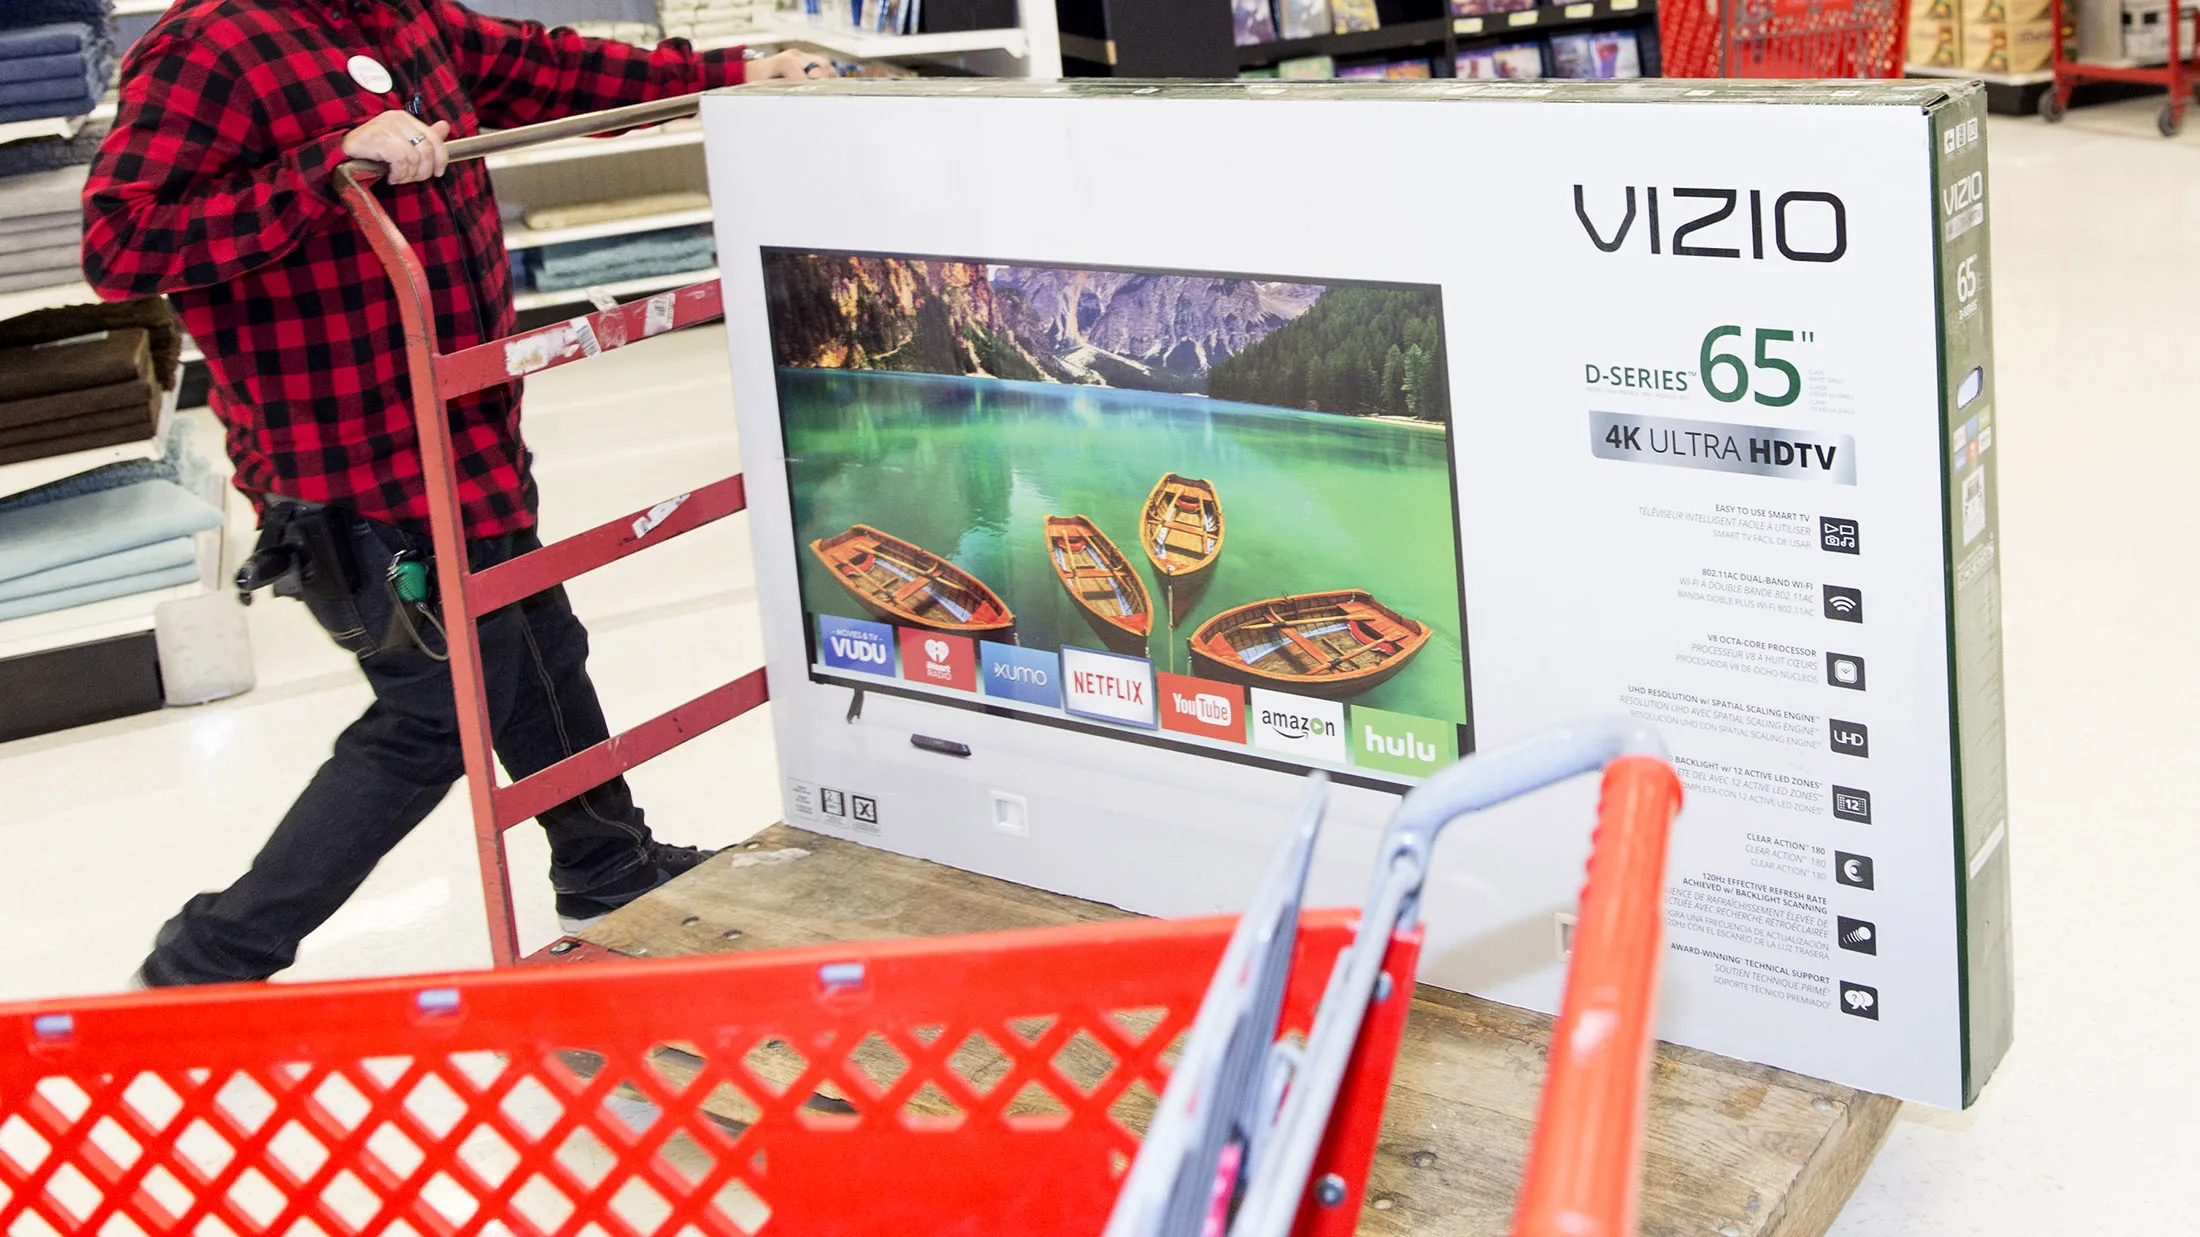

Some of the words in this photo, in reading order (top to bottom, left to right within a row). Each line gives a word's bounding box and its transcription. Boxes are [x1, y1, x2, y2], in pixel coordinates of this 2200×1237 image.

[1943, 170, 1983, 215] VIZIO
[1573, 184, 1847, 263] VIZIO
[1700, 324, 1814, 407] 65"
[1605, 424, 1642, 451] 4K
[1650, 428, 1741, 463] ULTRA
[1750, 438, 1837, 470] HDTV
[1716, 505, 1735, 513] EASY
[1738, 507, 1748, 515] TO
[1751, 509, 1766, 517] USE
[1768, 511, 1797, 520] SMART
[1713, 530, 1739, 540] SMART
[1742, 533, 1753, 542] TV
[1777, 537, 1787, 546] DE
[1789, 539, 1811, 549] USAR
[1738, 519, 1764, 530] FACILE
[1775, 524, 1811, 535] UTILISER
[1702, 569, 1737, 580] 802.11AC
[1741, 574, 1789, 586] DUAL-BAND
[1792, 581, 1812, 589] WI-FI
[1708, 581, 1742, 593] DOUBLE
[1744, 586, 1772, 597] BANDE
[1775, 590, 1813, 603] 802.11AC
[830, 636, 886, 664] VUDU
[1691, 643, 1743, 659] PROCESSEUR
[1745, 652, 1755, 660] V8
[1708, 634, 1717, 642] V8
[1720, 636, 1765, 649] OCTA-CORE
[1768, 643, 1816, 657] PROCESSOR
[1074, 670, 1143, 705] NETFLIX
[1172, 692, 1229, 722] YouTube
[1628, 685, 1645, 694] UHD
[1648, 688, 1697, 703] RESOLUTION
[1712, 699, 1744, 711] SPATIAL
[1746, 705, 1781, 717] SCALING
[1262, 709, 1335, 737] amazon
[1671, 704, 1689, 714] UHD
[1691, 708, 1711, 718] AVEC
[1713, 711, 1743, 723] SPATIAL
[1746, 717, 1781, 729] SCALING
[1365, 725, 1436, 762] hulu
[1680, 719, 1697, 728] UHD
[1699, 722, 1717, 731] CON
[1719, 725, 1748, 737] SPATIAL
[1751, 731, 1784, 743] SCALING
[1834, 730, 1864, 746] UHD
[1675, 756, 1718, 770] BACKLIGHT
[1734, 767, 1742, 775] 12
[1745, 769, 1772, 780] ACTIVE
[1775, 774, 1789, 783] LED
[1692, 771, 1706, 781] DEL
[1708, 774, 1728, 785] AVEC
[1732, 778, 1741, 787] 12
[1743, 780, 1769, 792] ACTIVE
[1772, 786, 1788, 795] LED
[1845, 798, 1860, 810] 12
[1745, 844, 1770, 856] CLEAR
[1812, 857, 1826, 868] 180
[1747, 833, 1772, 844] CLEAR
[1812, 846, 1825, 855] 180
[1751, 858, 1774, 870] CLEAR
[1812, 871, 1826, 880] 180
[1683, 878, 1721, 892] ACHIEVED
[1736, 889, 1780, 904] BACKLIGHT
[1783, 899, 1827, 914] SCANNING
[1703, 873, 1725, 884] 120Hz
[1728, 878, 1767, 892] EFFECTIVE
[1769, 887, 1803, 900] REFRESH
[1807, 895, 1826, 905] RATE
[1694, 892, 1705, 901] DE
[1817, 918, 1828, 928] DE
[1694, 902, 1714, 913] AVEC
[1716, 907, 1763, 924] RECHERCHE
[1687, 913, 1703, 923] UNA
[1705, 917, 1752, 934] FRECUENCIA
[1754, 928, 1764, 937] DE
[1687, 923, 1704, 933] CON
[1707, 927, 1715, 935] EL
[1717, 929, 1752, 943] ESCANEO
[1754, 937, 1765, 946] DE
[1767, 940, 1776, 948] LA
[1778, 942, 1792, 952] LUZ
[1795, 946, 1829, 960] TRASERA
[1713, 976, 1748, 991] SOPORTE
[1715, 963, 1749, 978] SOUTIEN
[1752, 972, 1799, 990] TECHNIQUE
[1745, 959, 1789, 975] TECHNICAL
[1792, 970, 1829, 984] SUPPORT
